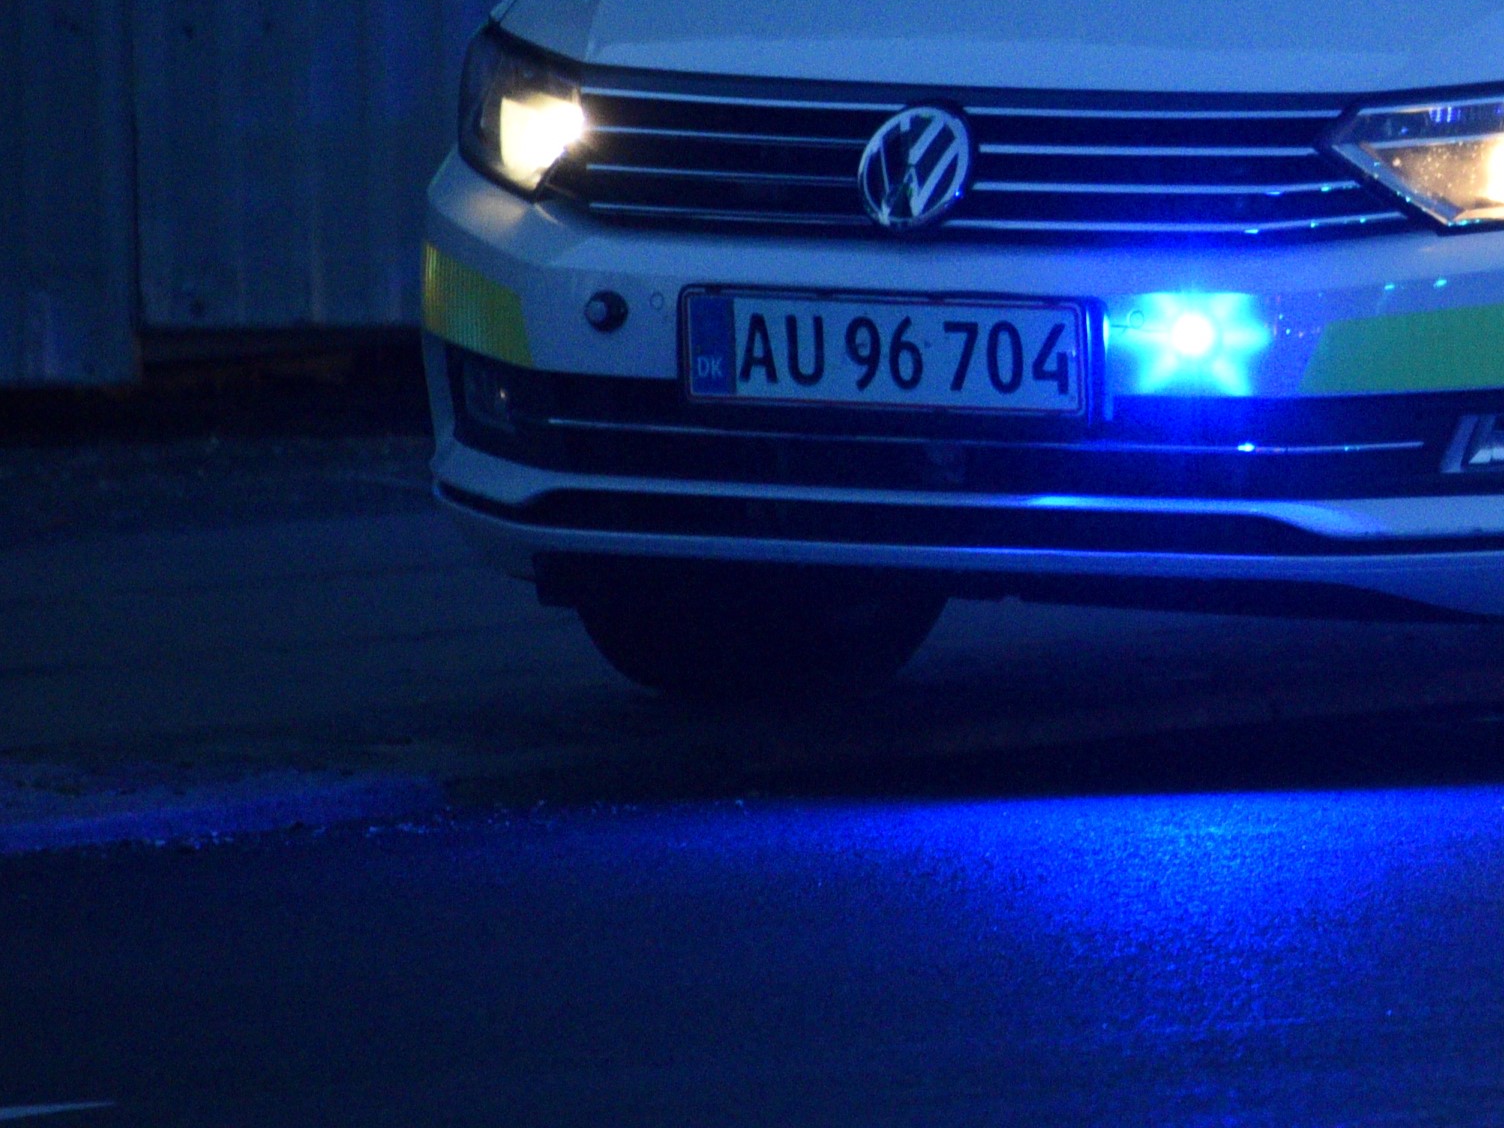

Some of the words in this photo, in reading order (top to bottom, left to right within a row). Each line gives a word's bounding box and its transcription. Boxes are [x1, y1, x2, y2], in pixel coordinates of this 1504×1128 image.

[697, 355, 723, 379] DK
[739, 313, 825, 386] AU
[845, 316, 923, 391] 96
[943, 321, 1069, 395] 704
